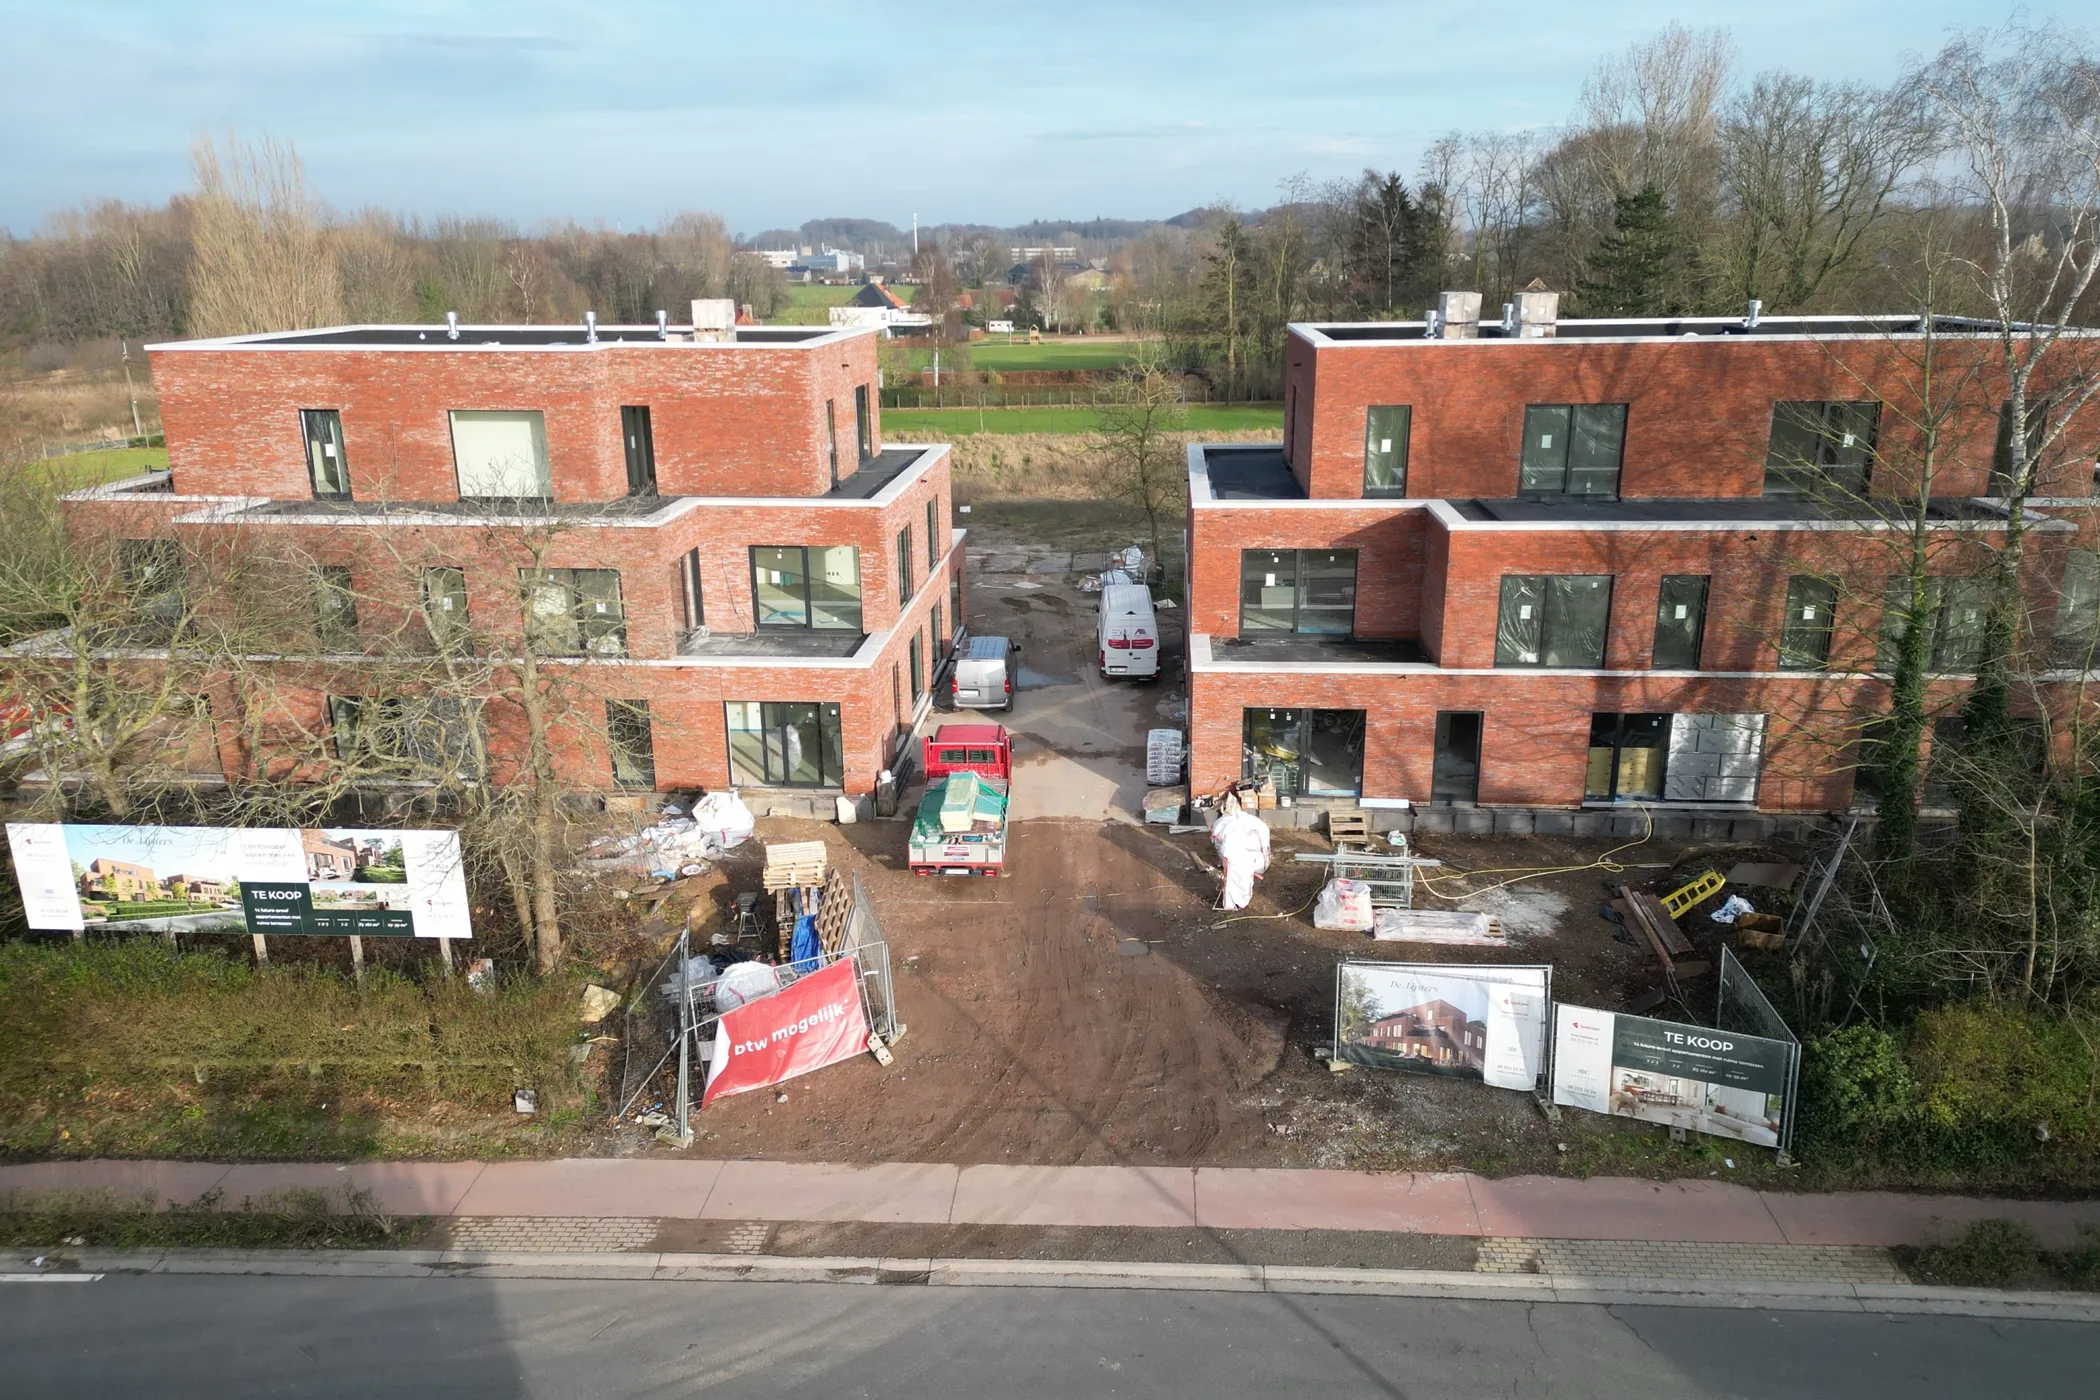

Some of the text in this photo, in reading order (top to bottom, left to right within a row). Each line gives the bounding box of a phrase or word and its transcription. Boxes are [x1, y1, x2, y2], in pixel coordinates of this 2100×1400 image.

[251, 890, 302, 900] TE KOOP
[734, 1037, 768, 1056] btw
[1664, 1031, 1734, 1052] TE KOOP
